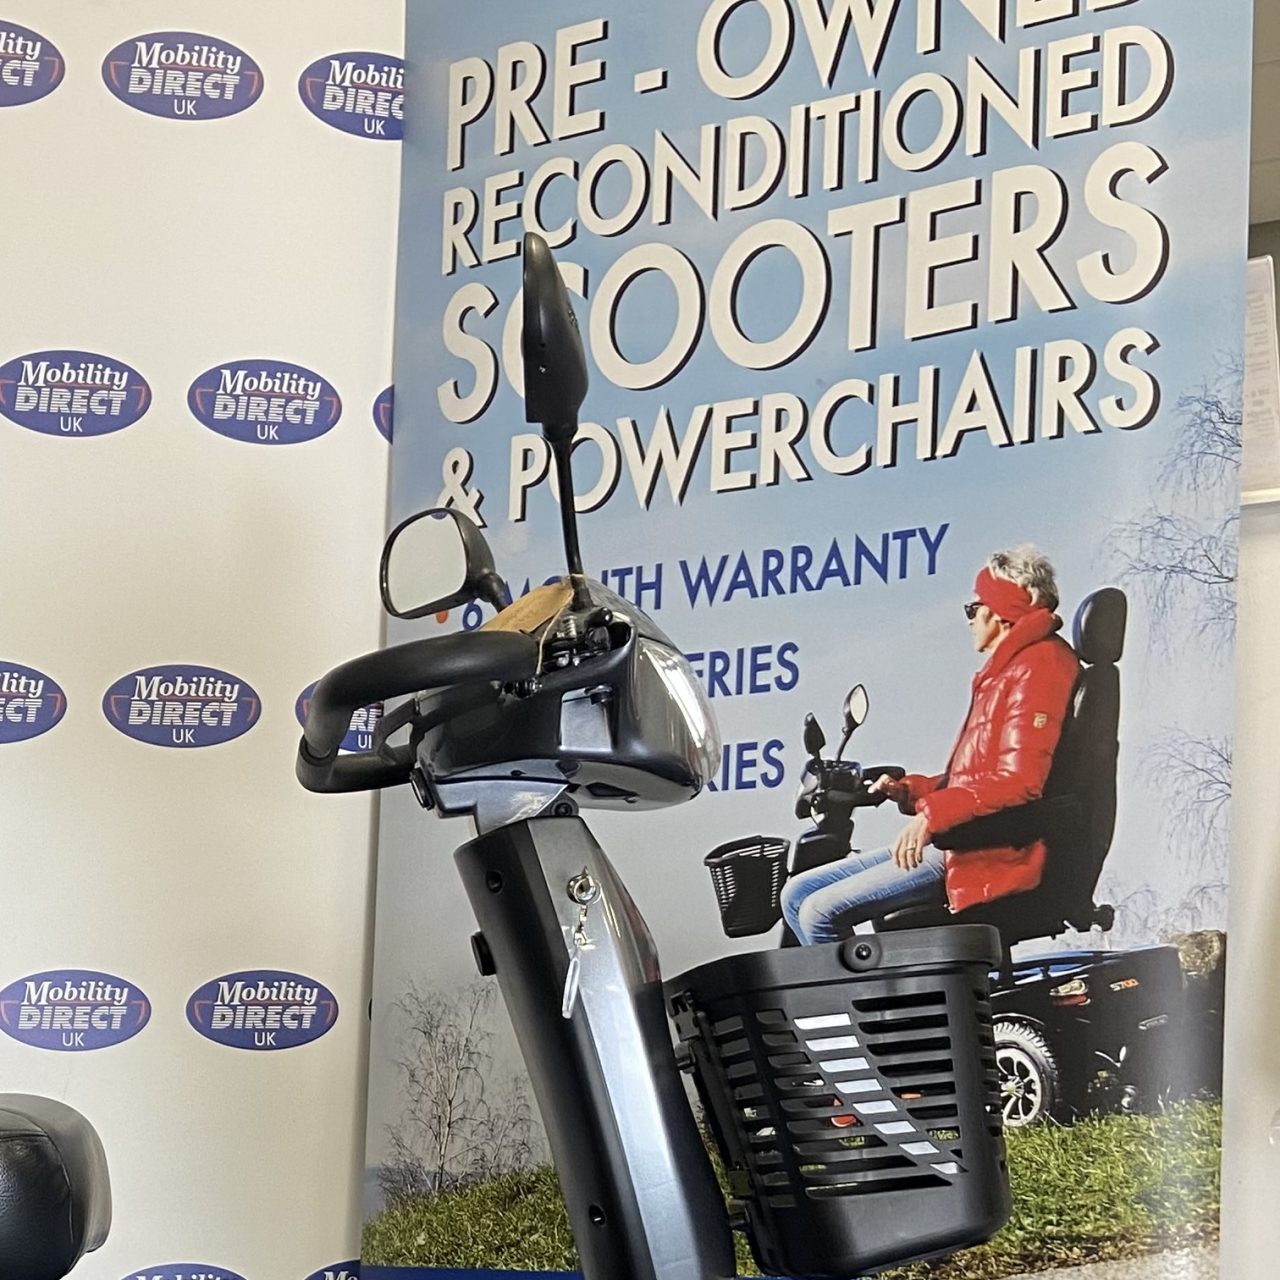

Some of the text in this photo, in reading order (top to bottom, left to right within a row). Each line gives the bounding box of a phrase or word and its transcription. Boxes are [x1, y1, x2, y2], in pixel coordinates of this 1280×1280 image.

[131, 41, 242, 74] Mobility
[128, 67, 240, 100] DIRECT
[447, 18, 607, 171] PRE
[173, 98, 196, 116] UK
[364, 117, 385, 135] UK
[441, 26, 1174, 277] RECONDITIONED
[17, 360, 128, 390] Mobility
[216, 369, 322, 400] Mobility
[14, 386, 127, 415] DIRECT
[213, 394, 320, 425] DIRECT
[60, 415, 83, 432] UK
[256, 424, 278, 440] UK
[436, 448, 487, 528] &
[508, 327, 1160, 523] POWERCHAIRS
[463, 598, 483, 632] 6
[679, 523, 950, 608] WARRANTY
[130, 675, 239, 702] Mobility
[128, 701, 238, 726] DIRECT
[172, 728, 194, 743] UK
[20, 981, 129, 1005] Mobility
[214, 981, 318, 1005] Mobility
[18, 1005, 127, 1029] DIRECT
[211, 1005, 317, 1029] DIRECT
[62, 1032, 84, 1047] UK
[254, 1031, 275, 1046] UK
